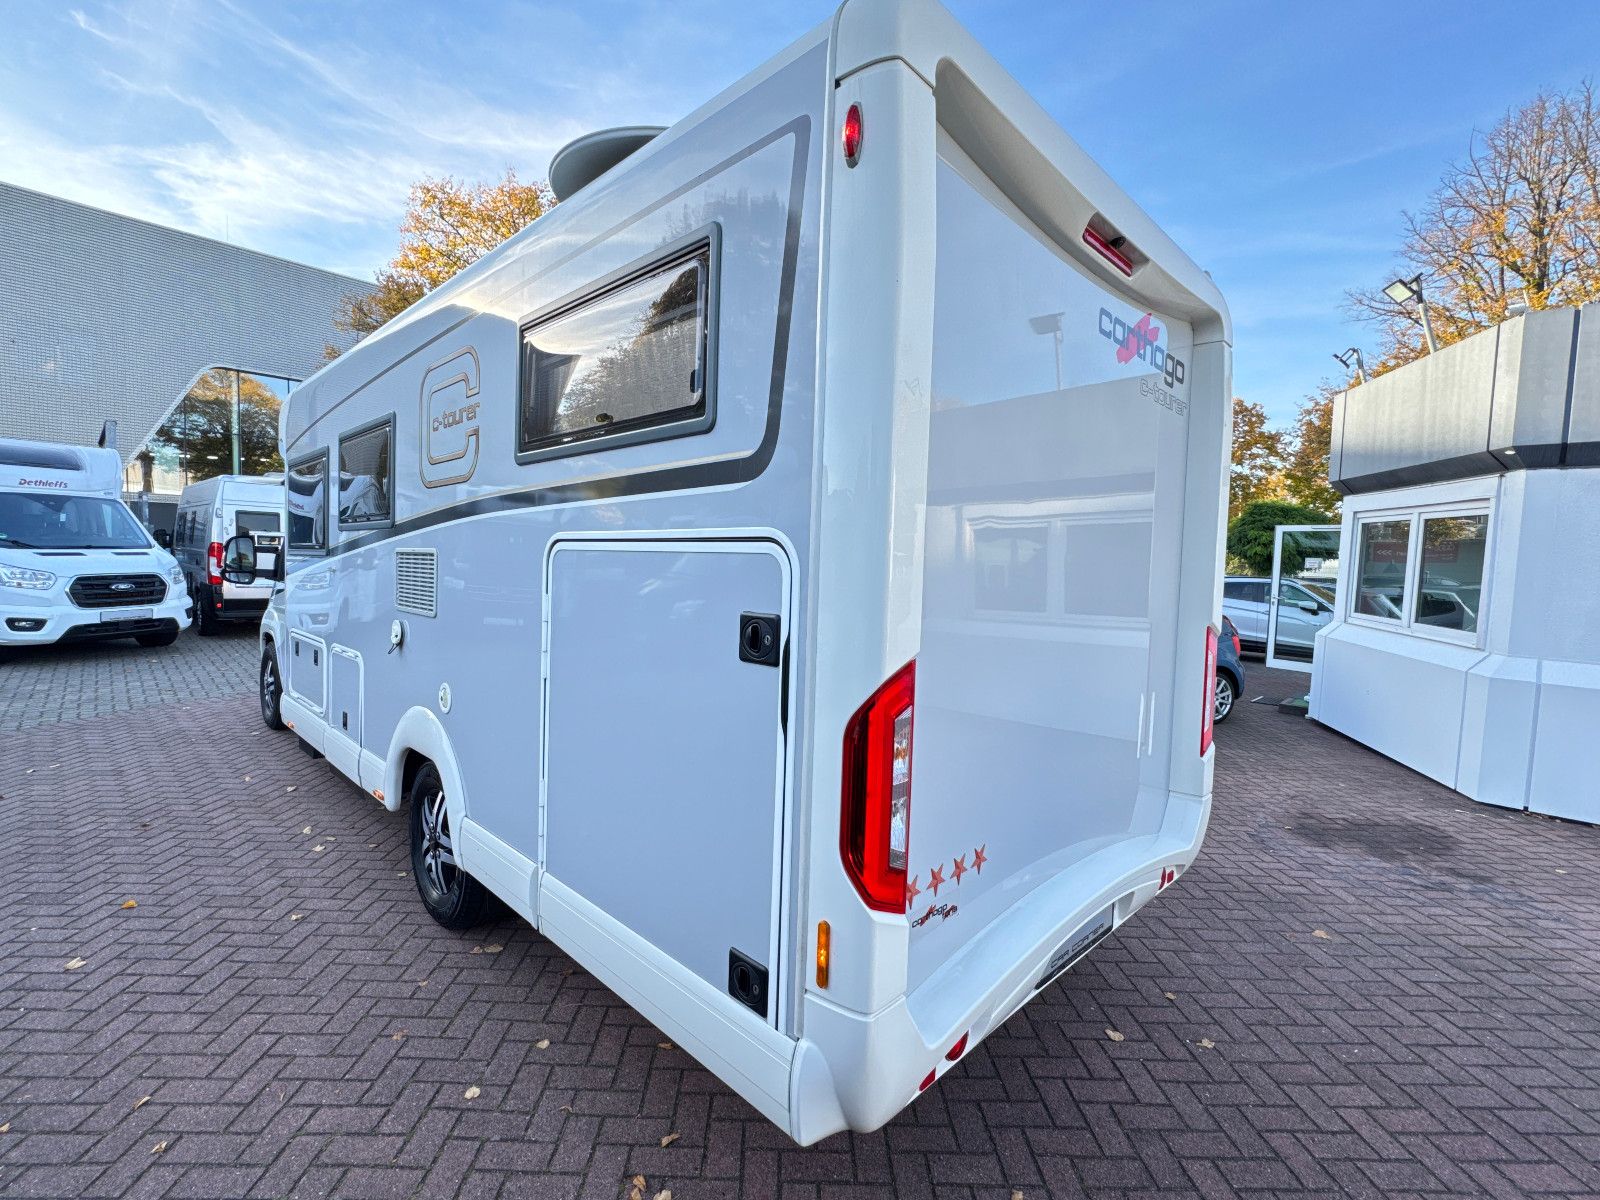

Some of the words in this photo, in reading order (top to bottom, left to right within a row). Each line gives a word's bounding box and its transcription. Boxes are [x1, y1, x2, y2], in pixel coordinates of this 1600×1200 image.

[1098, 307, 1185, 389] carthago
[1139, 378, 1188, 417] c-tourer
[432, 401, 481, 432] c-tourer
[18, 478, 68, 489] Dethleffs
